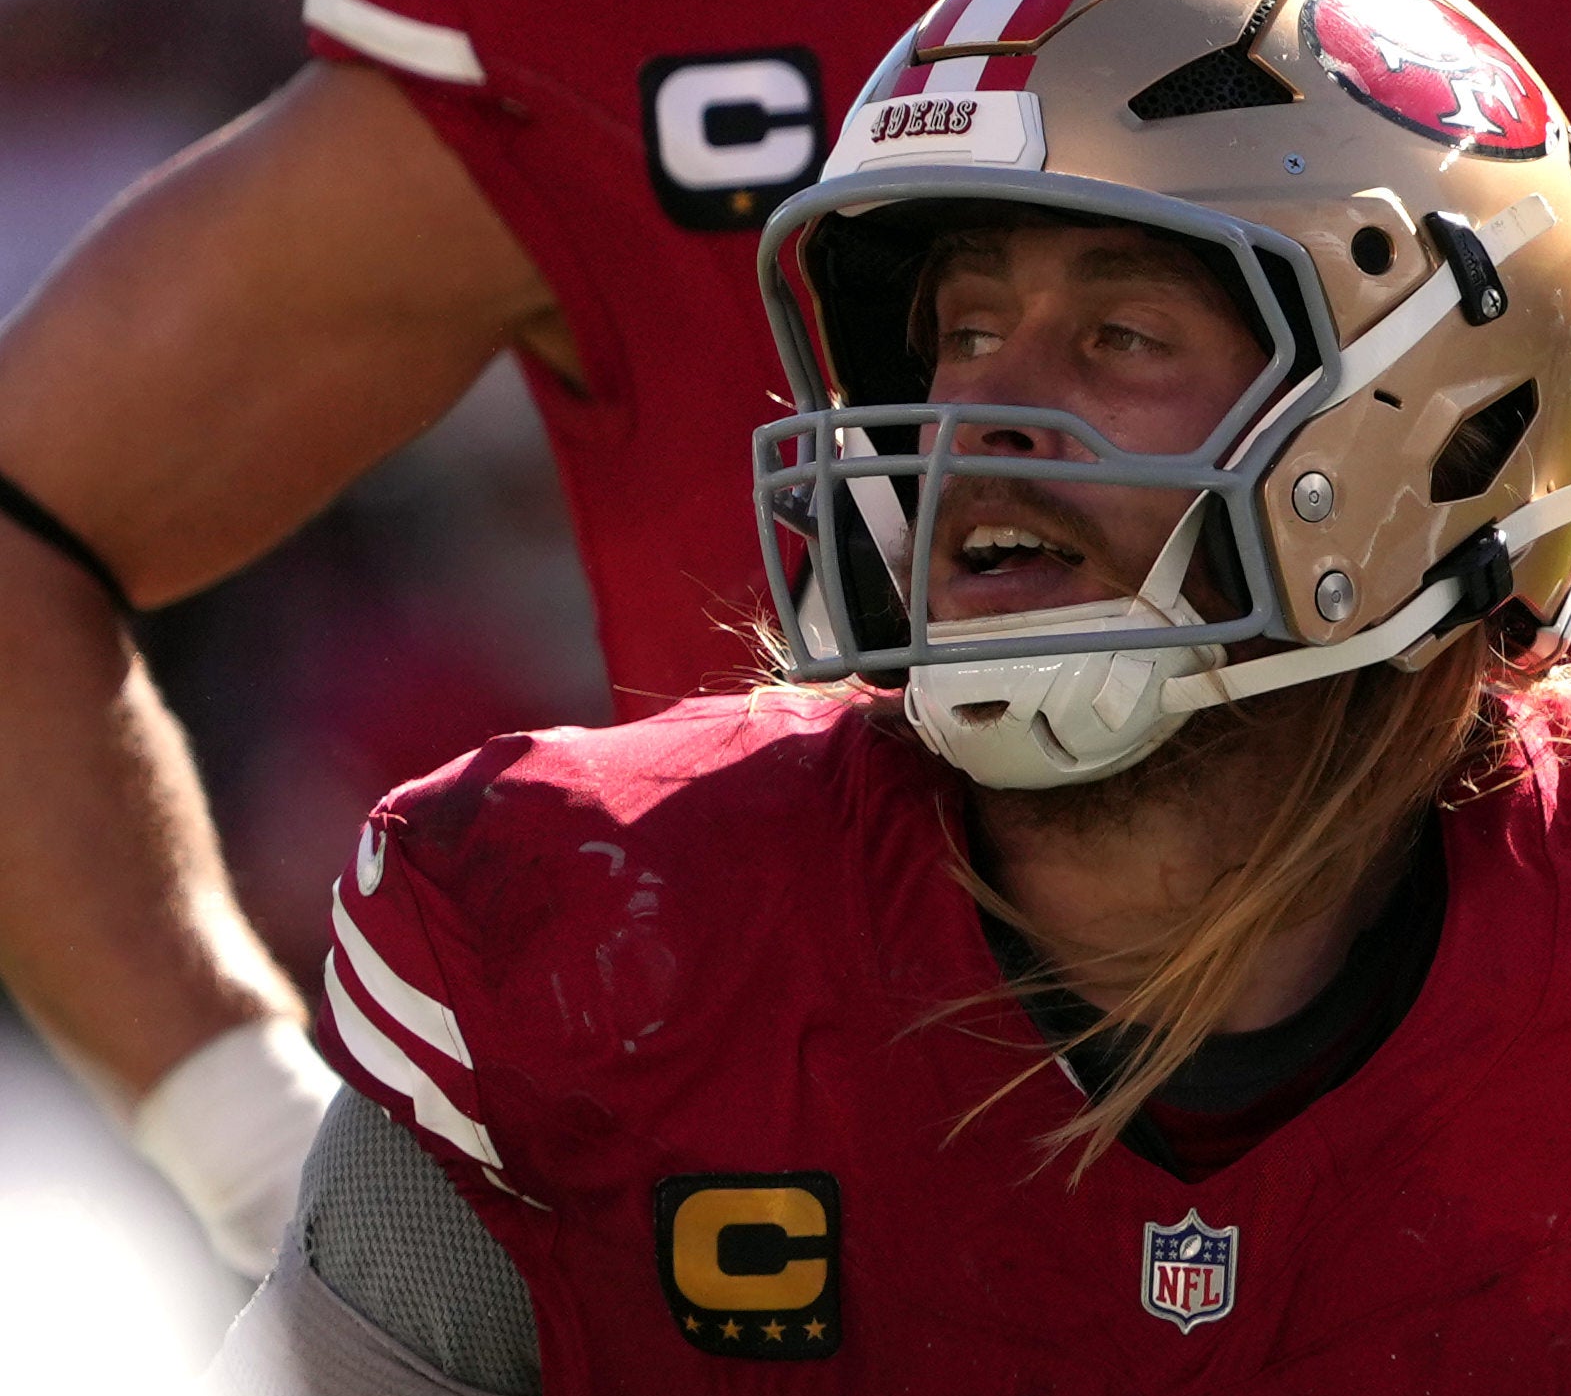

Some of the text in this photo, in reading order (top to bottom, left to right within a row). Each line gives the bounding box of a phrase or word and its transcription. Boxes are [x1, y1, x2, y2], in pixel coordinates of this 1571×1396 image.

[655, 59, 815, 190] C
[871, 99, 978, 143] 49ERS
[672, 1188, 828, 1311] C
[1155, 1265, 1221, 1312] NFL
